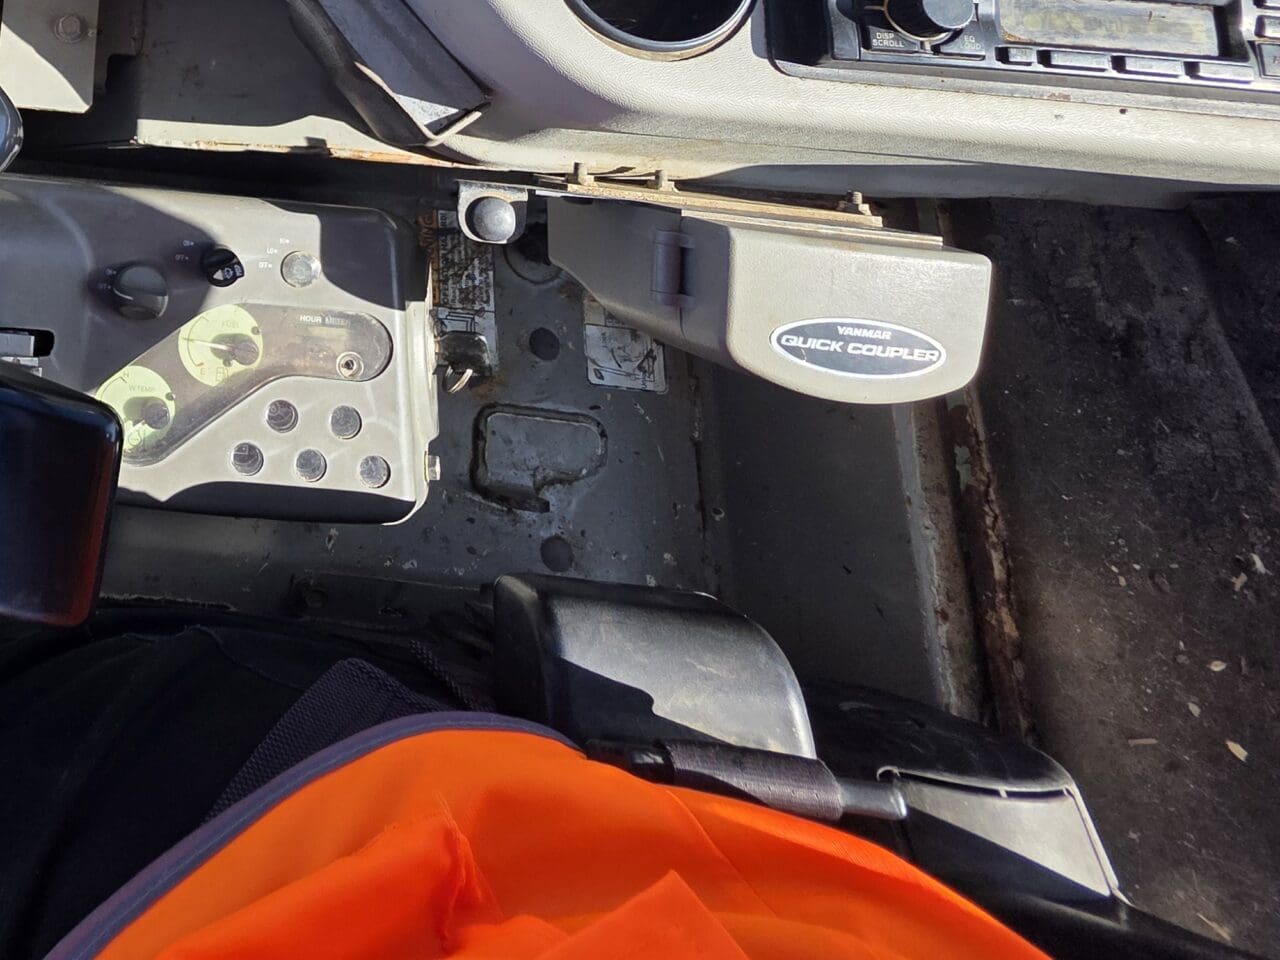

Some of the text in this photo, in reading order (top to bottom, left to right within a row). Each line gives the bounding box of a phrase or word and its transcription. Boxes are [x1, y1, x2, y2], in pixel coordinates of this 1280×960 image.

[876, 32, 895, 40] DISP
[872, 39, 905, 48] SCROLL
[299, 314, 322, 323] HOUR
[837, 326, 891, 339] YANMAR
[781, 334, 939, 361] QUICK COUPLER
